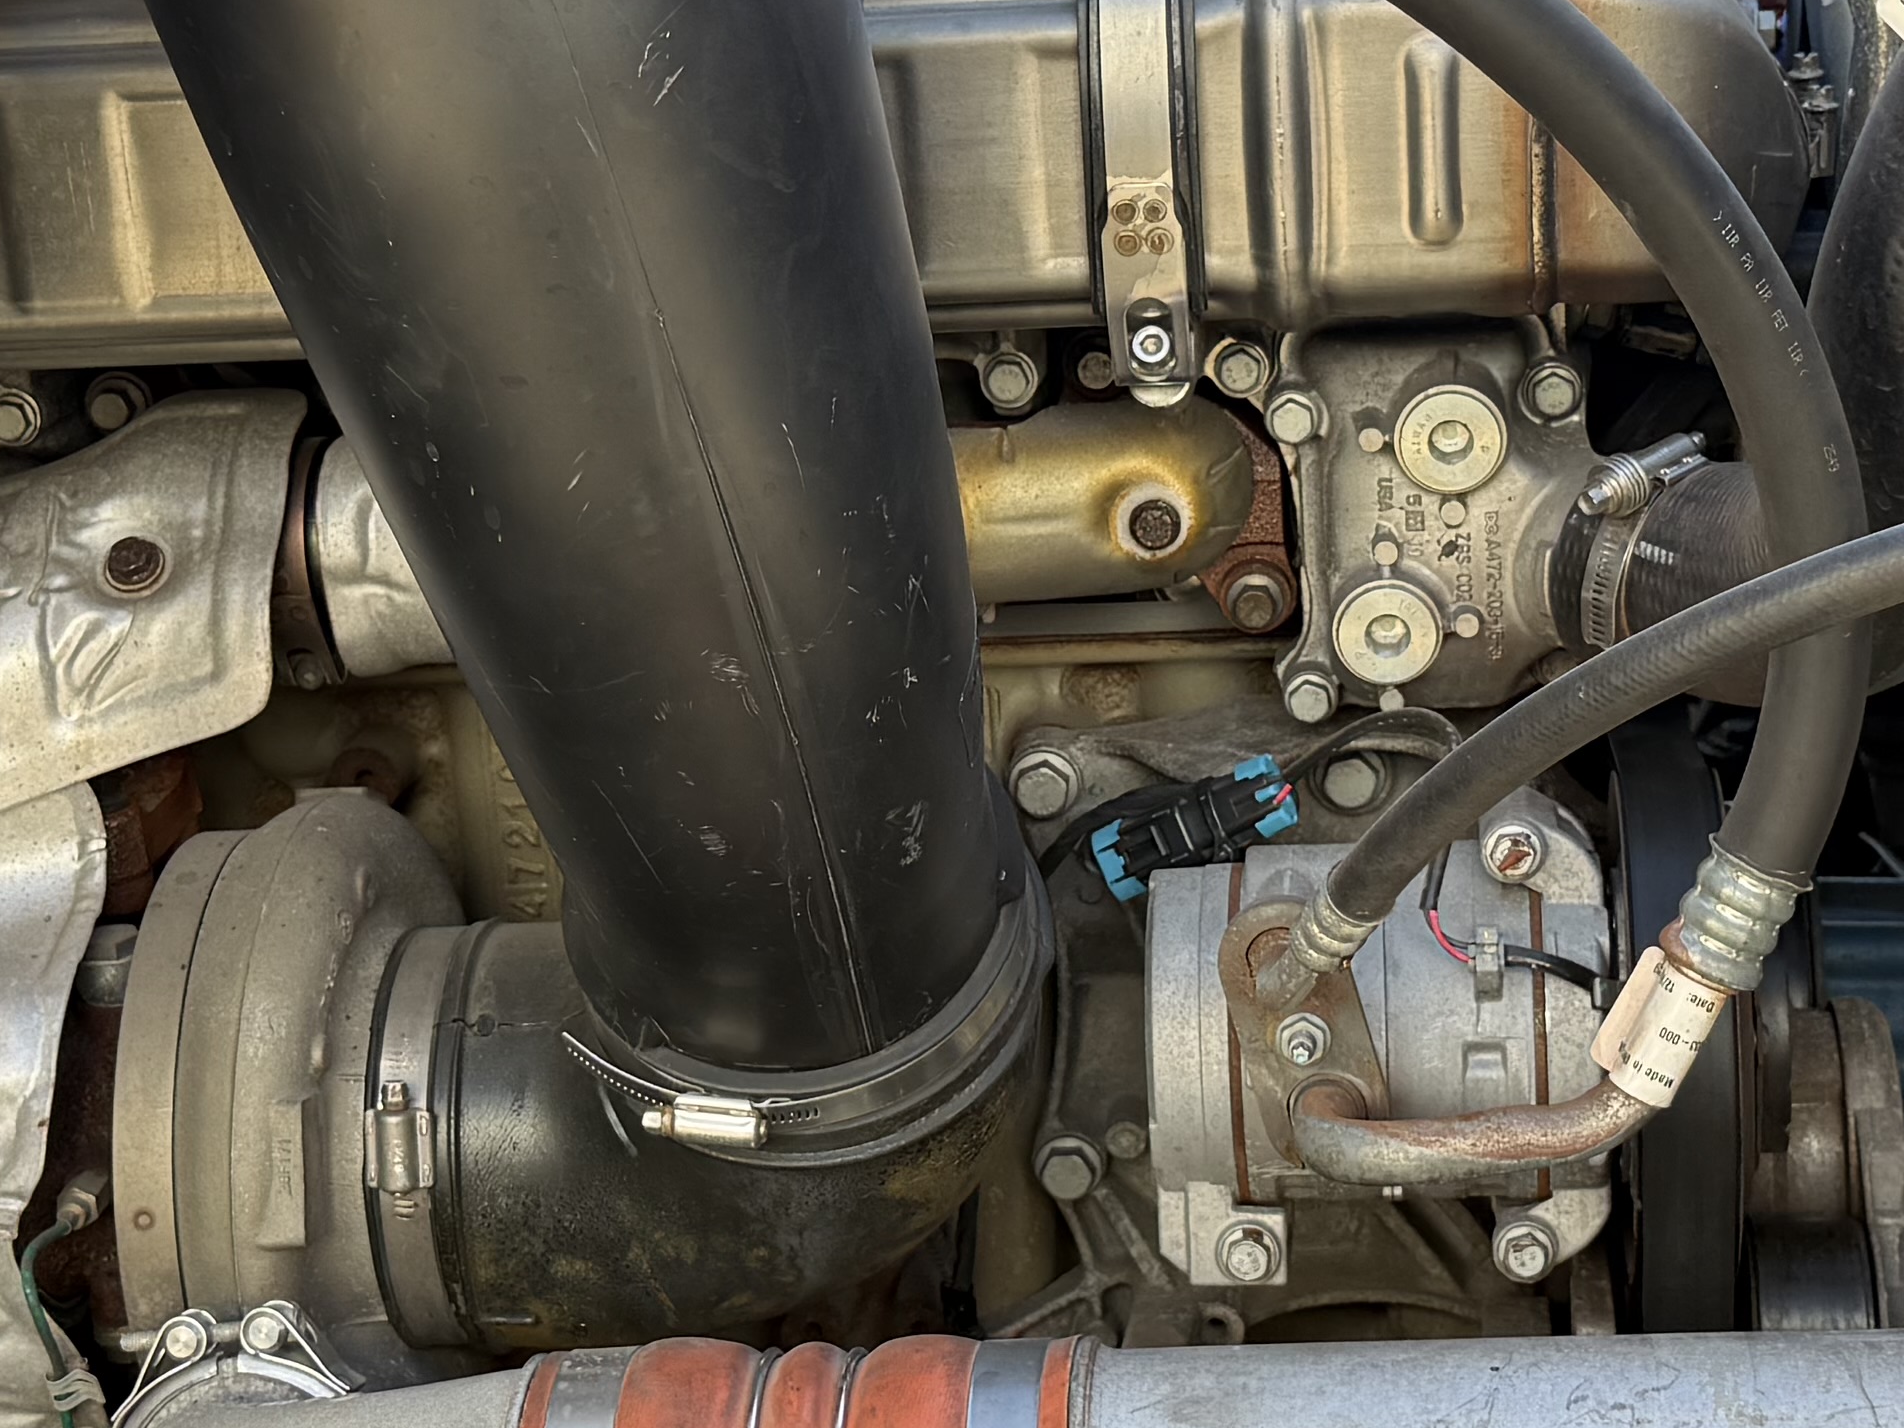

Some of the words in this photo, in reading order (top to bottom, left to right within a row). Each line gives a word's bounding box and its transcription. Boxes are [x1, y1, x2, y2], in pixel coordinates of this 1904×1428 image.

[1376, 476, 1395, 513] USA
[1686, 991, 1716, 1014] Date:
[1644, 1067, 1675, 1089] Made
